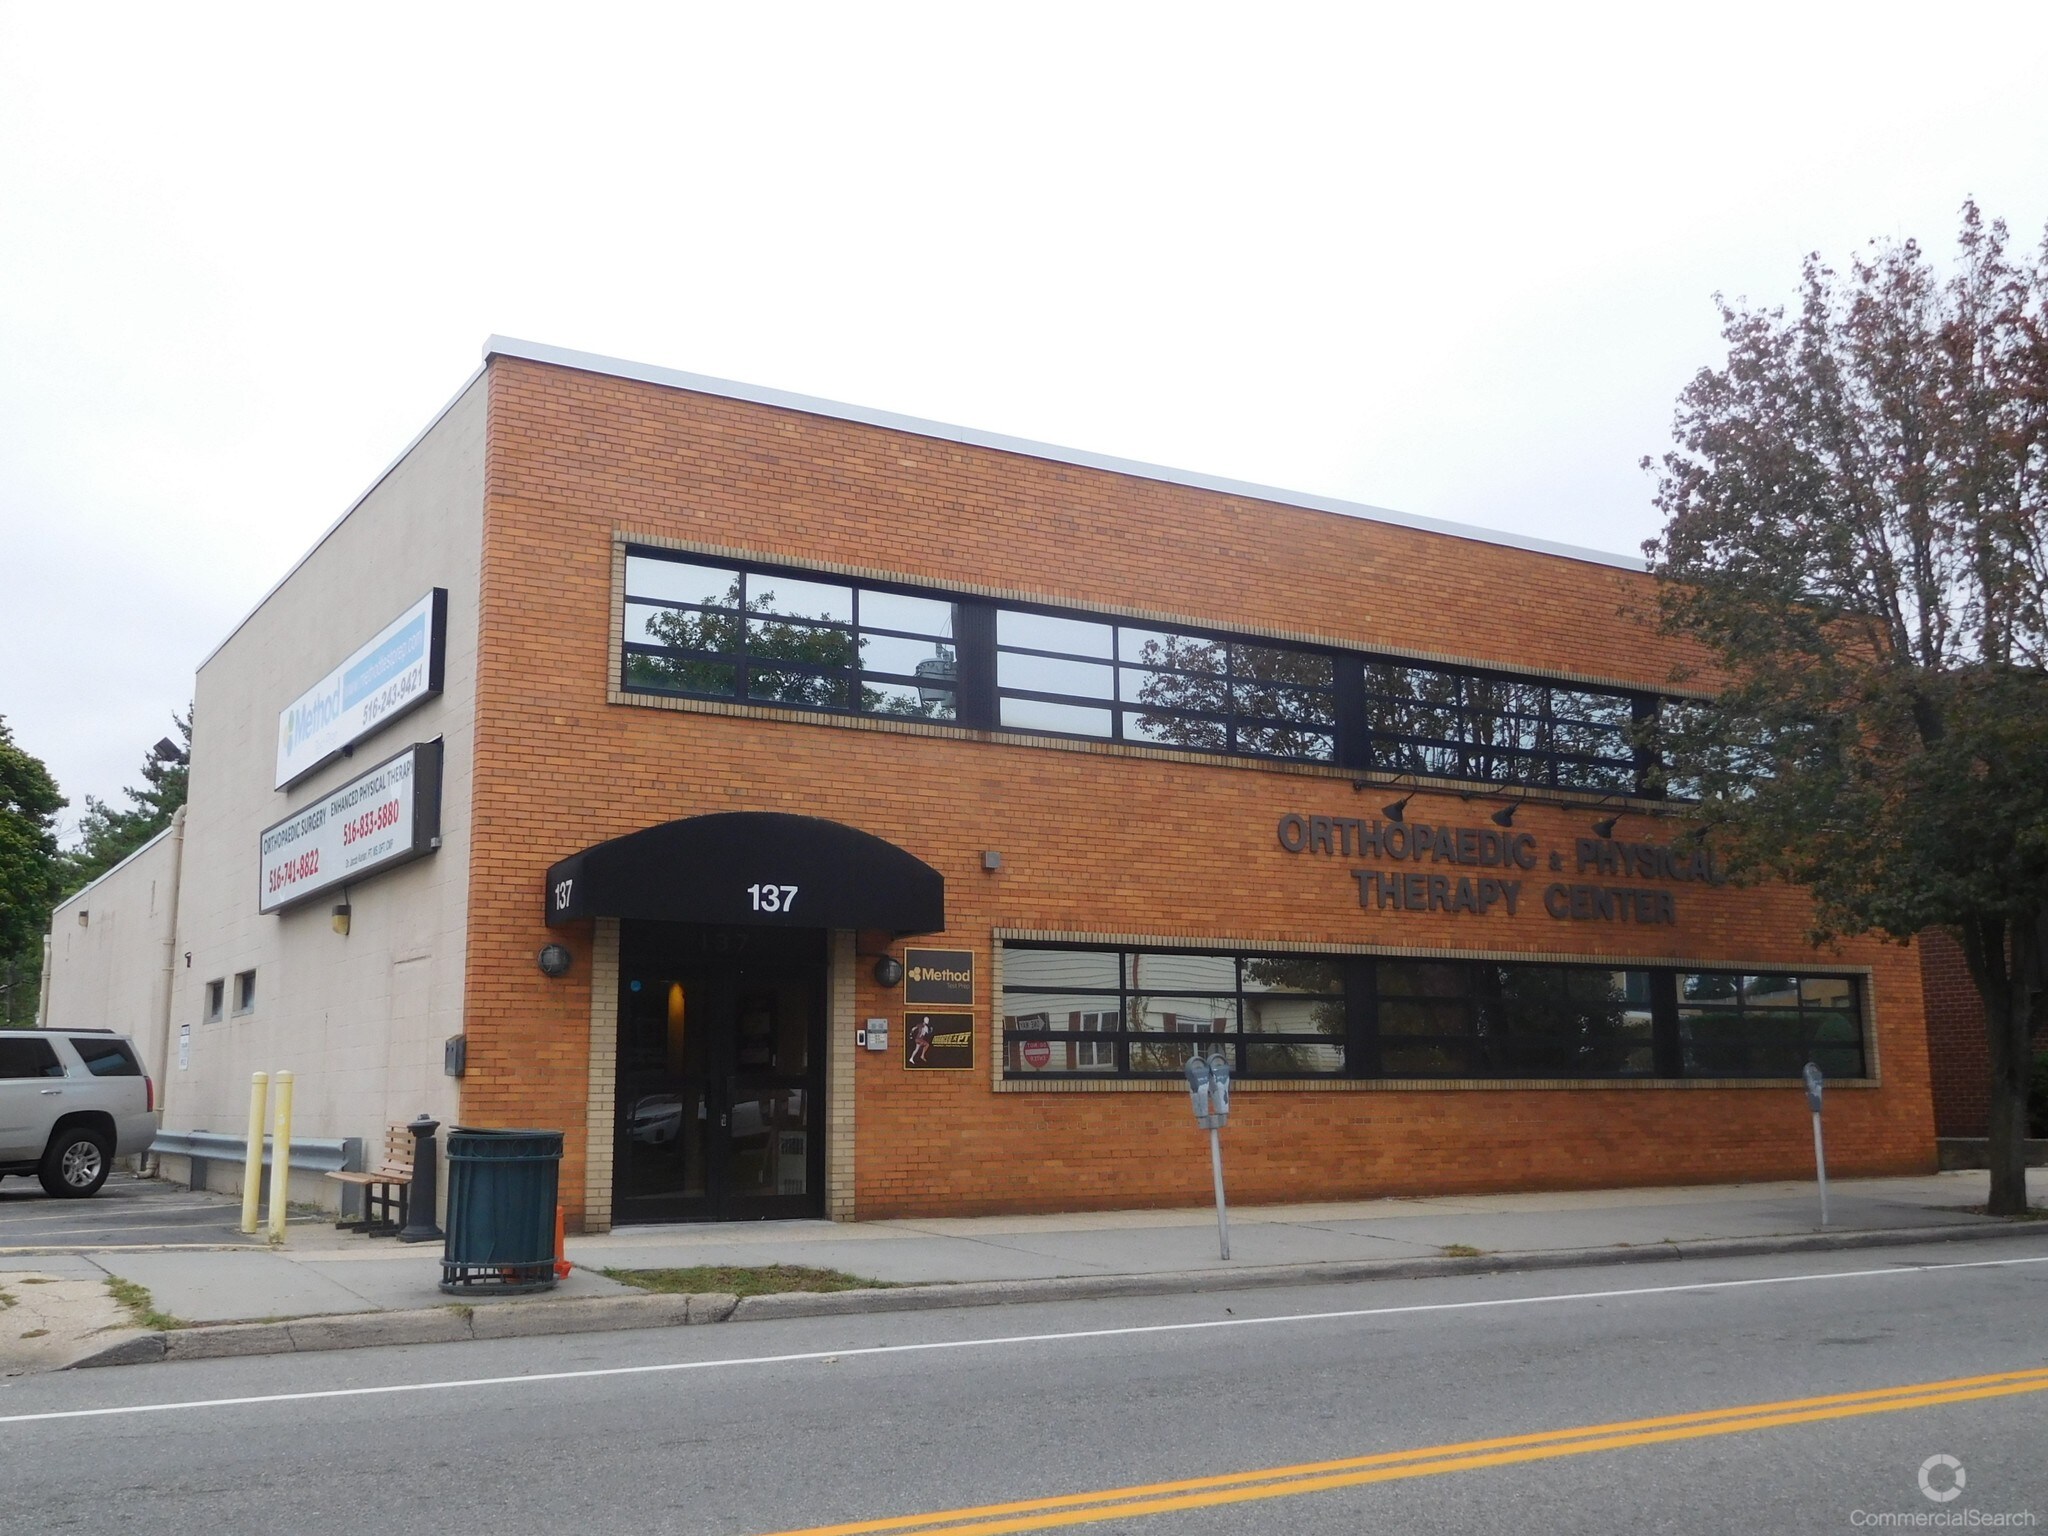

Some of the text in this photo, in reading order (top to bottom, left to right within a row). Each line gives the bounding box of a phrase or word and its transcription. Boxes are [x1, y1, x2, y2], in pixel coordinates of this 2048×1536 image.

[294, 677, 341, 746] Method
[362, 664, 423, 726] 516-243-9421
[331, 759, 413, 817] ENHANCED PHYSICAL THERAP
[263, 807, 327, 855] ORTHOPAEDIC SURGERY
[343, 798, 400, 847] 516-833-5880
[1277, 812, 1538, 870] ORTHOPAEDIC
[1549, 850, 1563, 871] &
[269, 847, 320, 894] 516-741-8822
[554, 878, 574, 911] 137
[747, 883, 799, 912] 137
[1350, 868, 1676, 926] THERAPY CENTER
[702, 932, 750, 953] 137
[922, 968, 970, 982] Method
[947, 982, 970, 991] Test Prep
